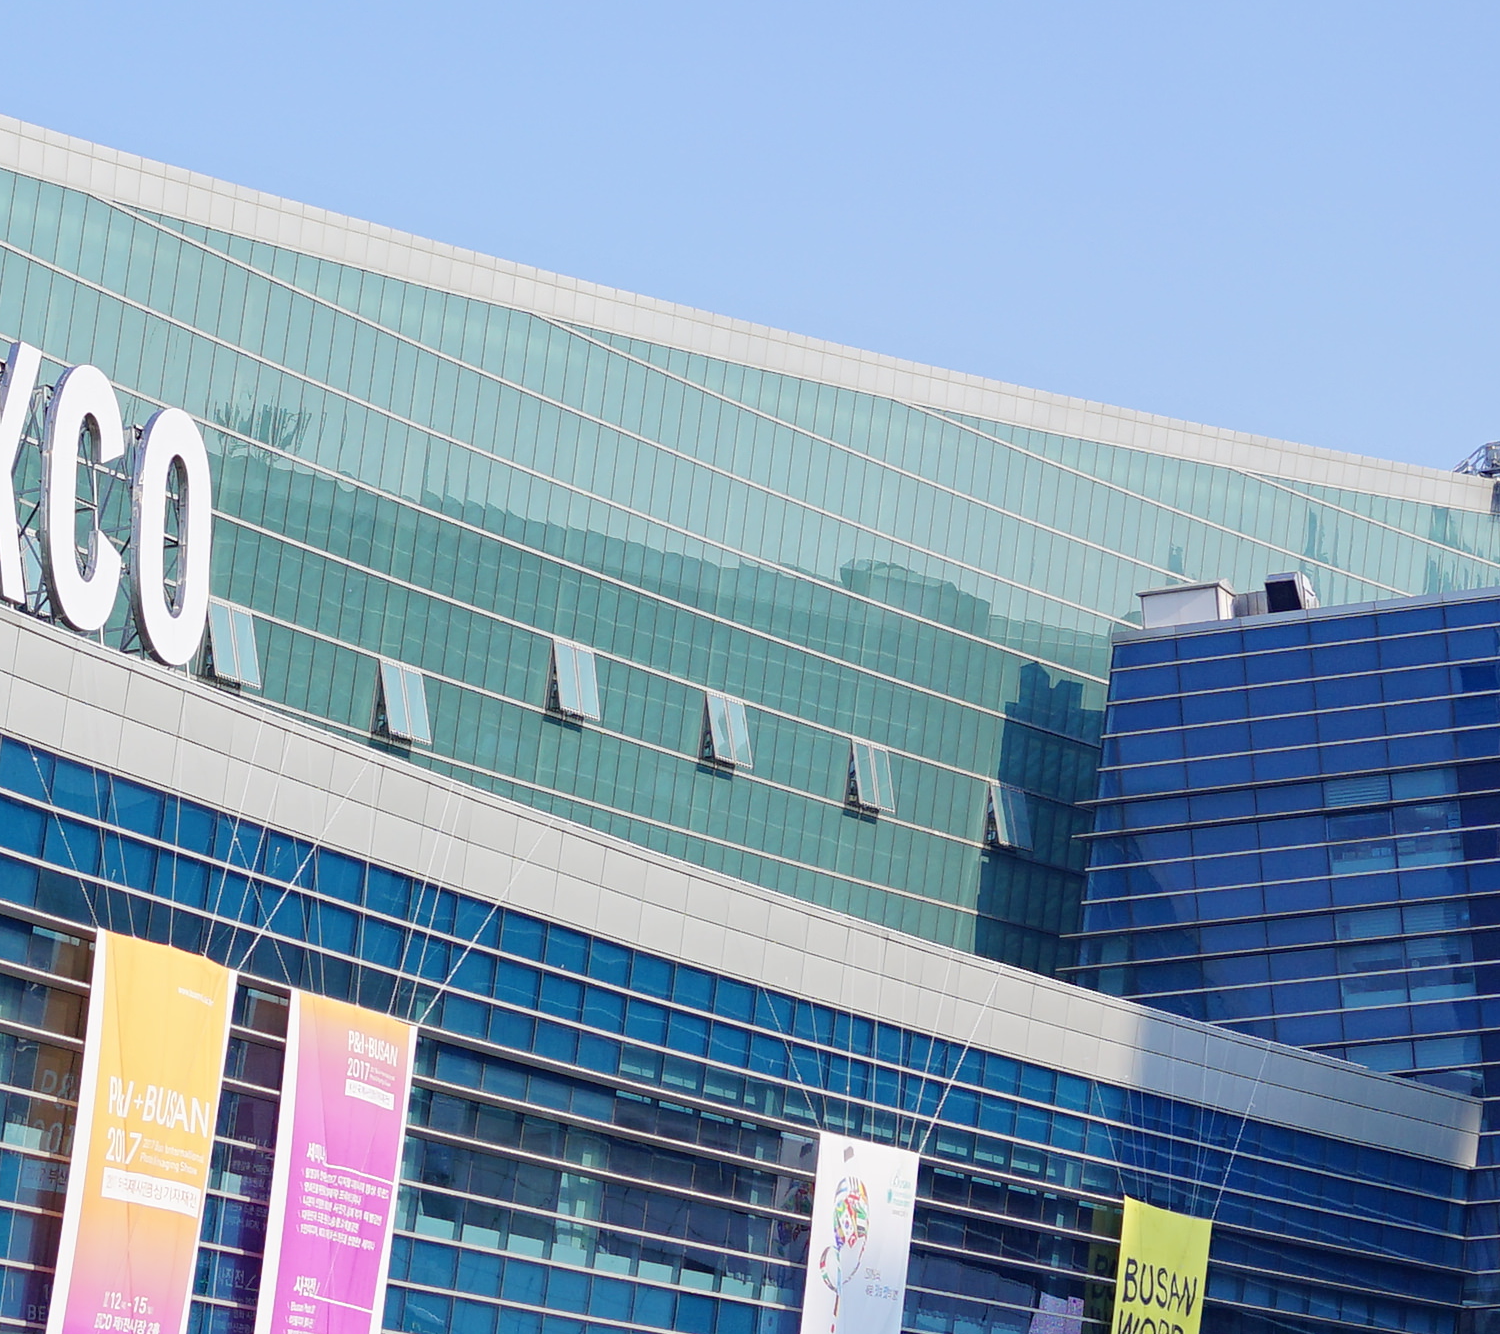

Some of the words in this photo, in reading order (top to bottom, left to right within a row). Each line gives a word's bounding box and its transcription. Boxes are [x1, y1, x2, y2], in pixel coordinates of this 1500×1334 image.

[347, 1029, 399, 1068] P&I+BUSAN
[346, 1057, 371, 1082] 2017
[105, 1126, 143, 1165] 2017
[1121, 1257, 1198, 1318] BUSAN
